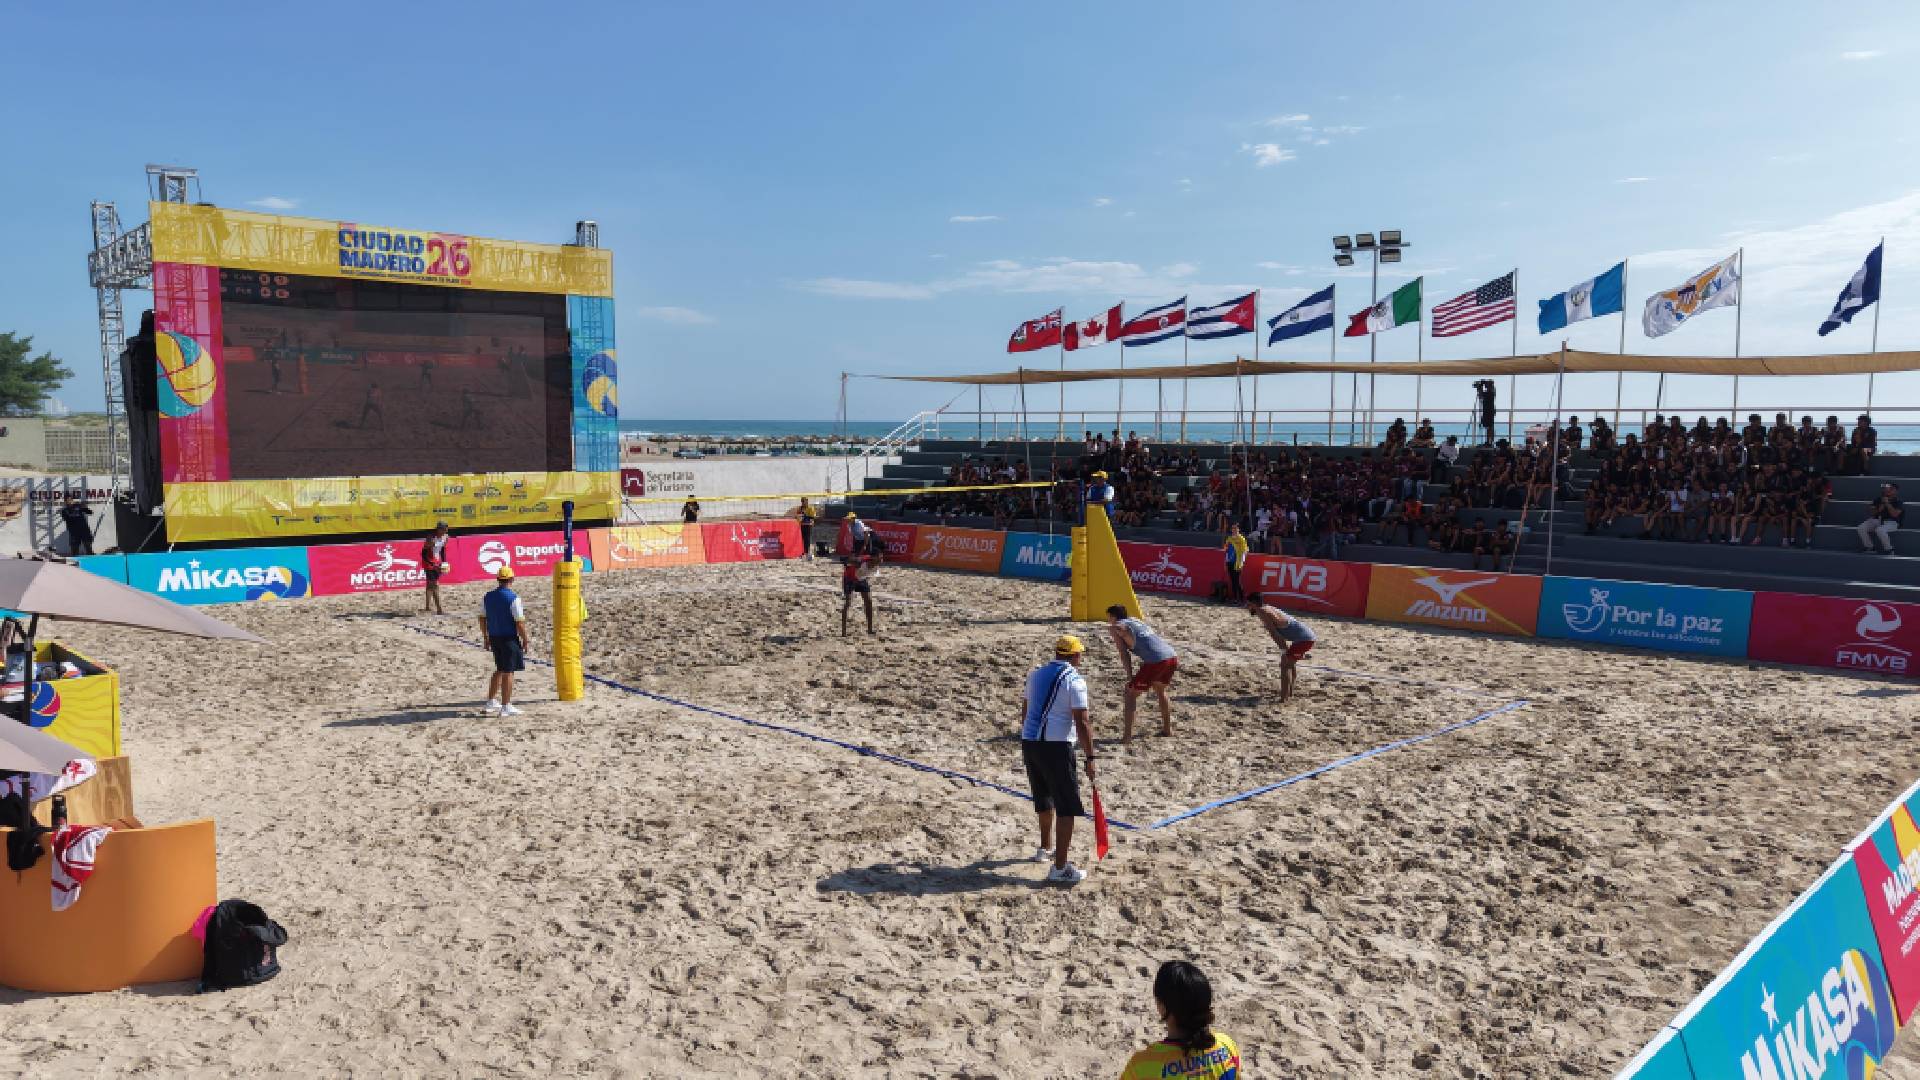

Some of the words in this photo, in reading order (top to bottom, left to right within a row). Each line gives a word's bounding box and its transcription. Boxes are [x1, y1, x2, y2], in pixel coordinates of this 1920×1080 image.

[339, 229, 424, 254] CIUDAD
[426, 238, 472, 279] 26
[339, 248, 424, 275] MADERO
[658, 481, 695, 492] Turismo
[945, 535, 998, 553] CONADE
[1131, 570, 1192, 588] NORCECA
[1261, 561, 1327, 593] FIVB
[1611, 605, 1653, 624] Por
[1656, 607, 1677, 627] la
[1681, 615, 1724, 634] paz
[1836, 650, 1907, 671] FMVB
